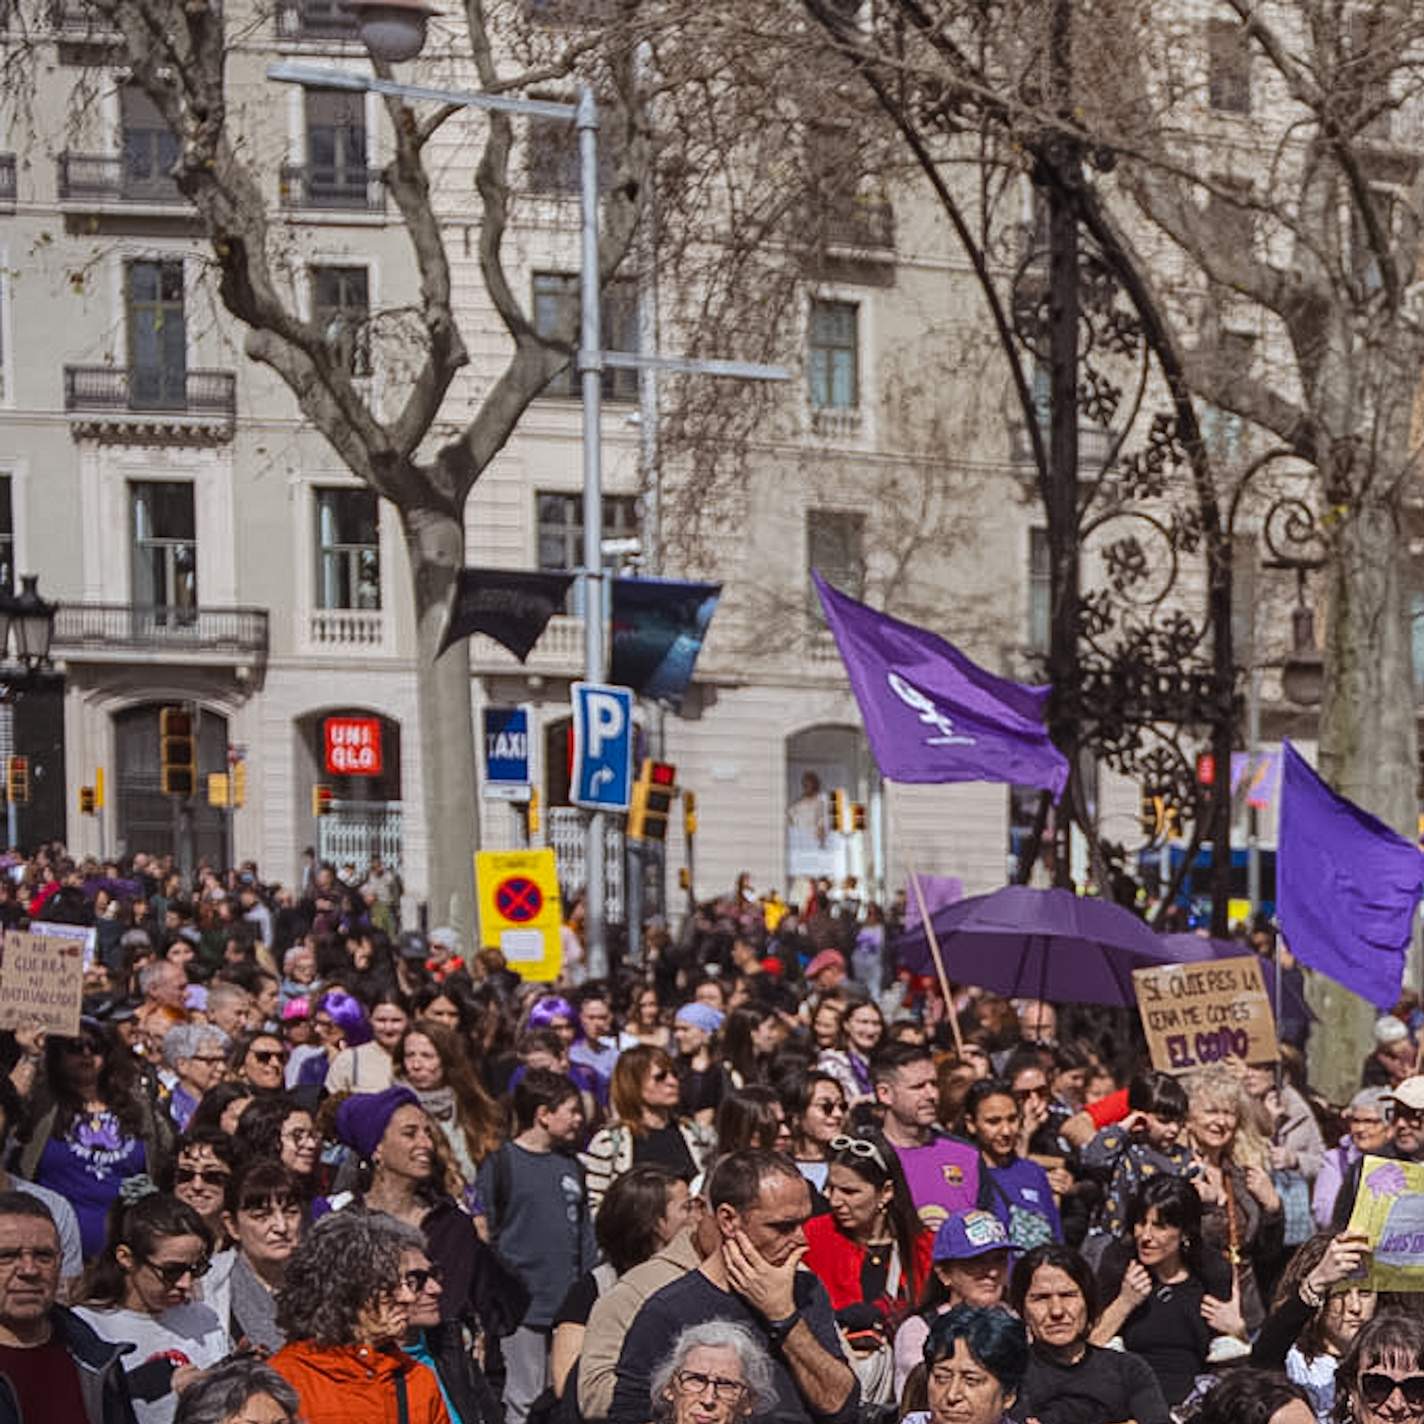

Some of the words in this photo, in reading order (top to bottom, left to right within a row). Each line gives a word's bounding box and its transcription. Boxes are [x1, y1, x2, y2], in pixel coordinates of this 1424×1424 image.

[330, 724, 372, 747] UNI
[586, 693, 625, 759] P
[330, 747, 374, 769] QLO
[488, 731, 528, 761] TAXI
[1142, 976, 1162, 1001] SI
[1169, 969, 1237, 999] QUIERES
[1241, 970, 1262, 992] LA
[1206, 1001, 1250, 1023] COMES
[1165, 1034, 1196, 1068] EL
